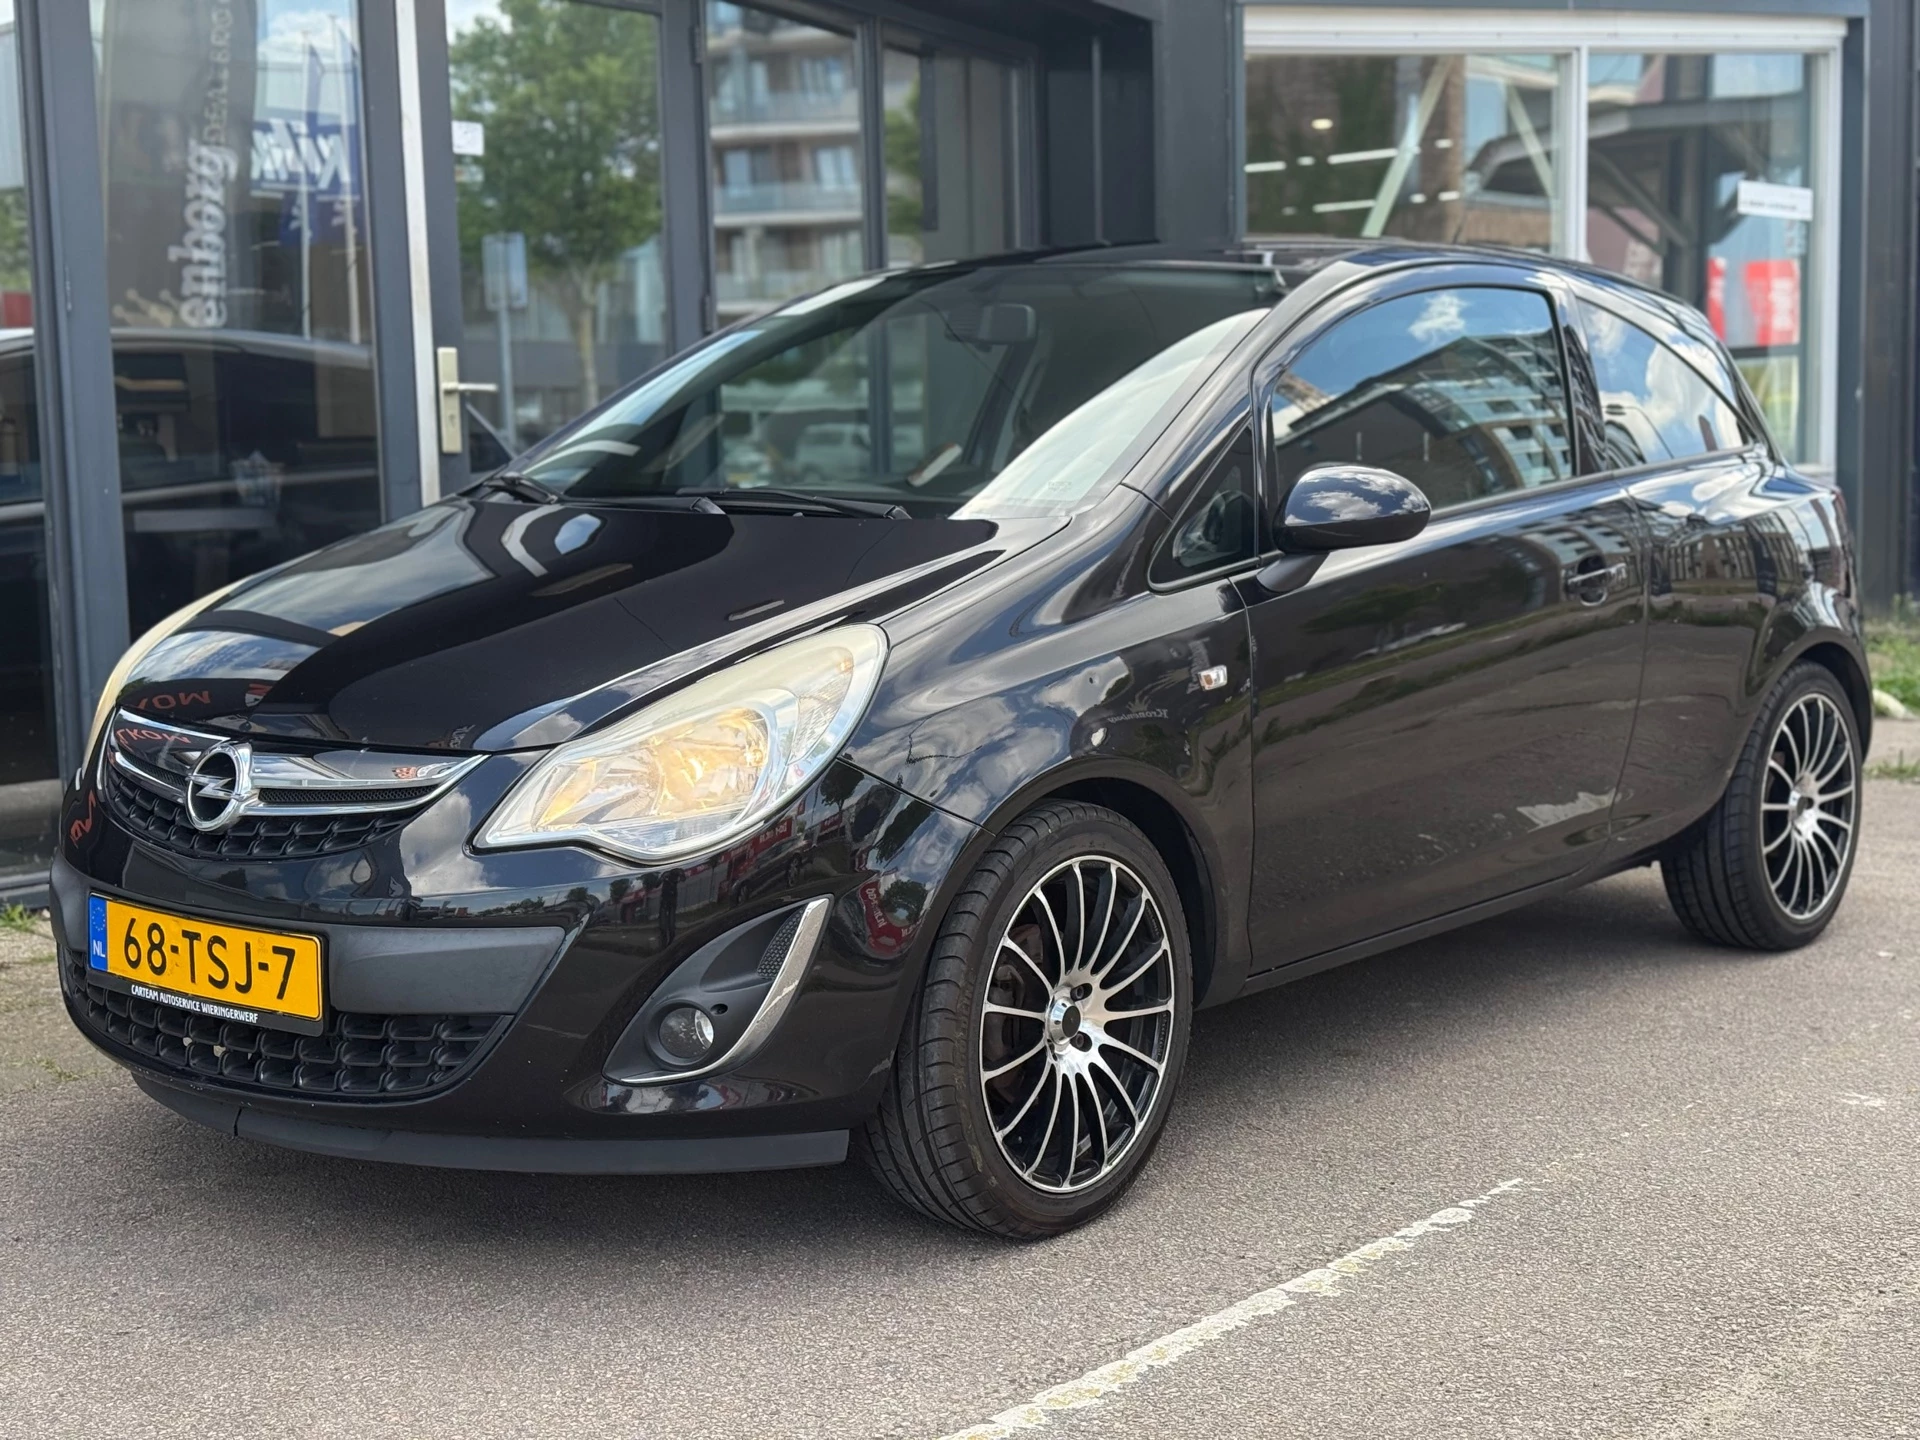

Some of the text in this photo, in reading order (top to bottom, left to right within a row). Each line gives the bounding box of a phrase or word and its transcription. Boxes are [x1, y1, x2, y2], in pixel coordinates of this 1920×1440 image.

[92, 939, 106, 958] NL
[124, 917, 296, 1000] 68-TSJ-7
[131, 984, 258, 1024] CARTEAM AUTOSERVICE WIERINGERWERF
